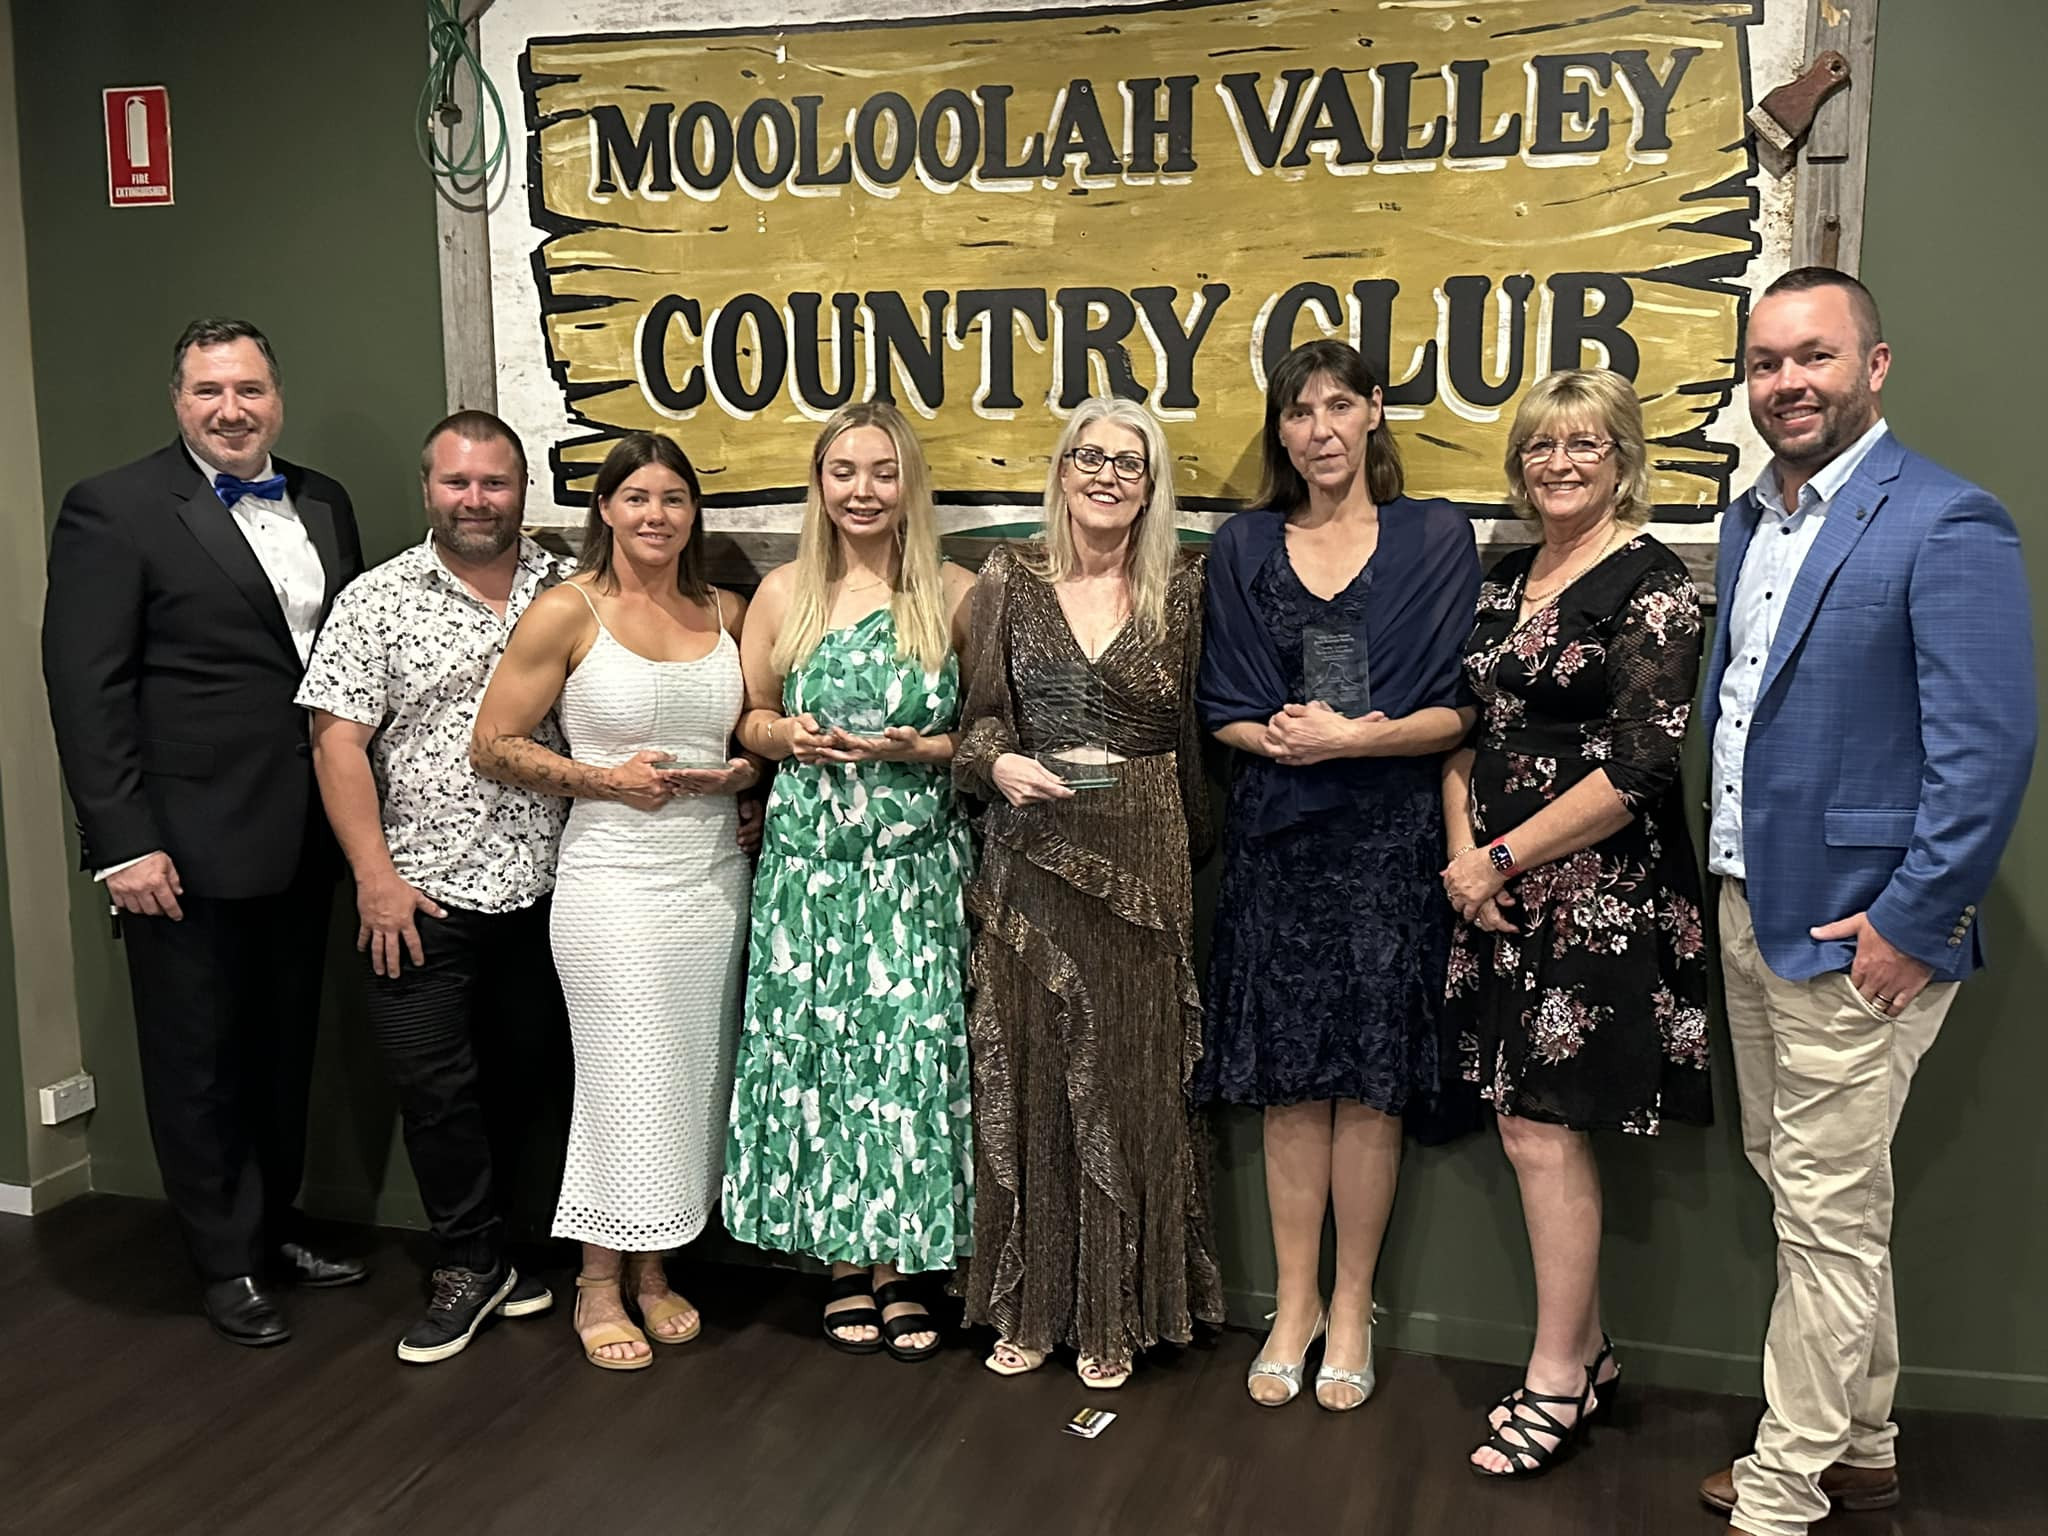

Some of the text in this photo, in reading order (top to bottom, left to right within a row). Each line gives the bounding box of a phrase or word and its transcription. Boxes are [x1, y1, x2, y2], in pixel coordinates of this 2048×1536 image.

[132, 173, 149, 185] FIRE
[590, 48, 1702, 195] MOOLOOLAH VALLEY
[640, 283, 1230, 412] COUNTRY
